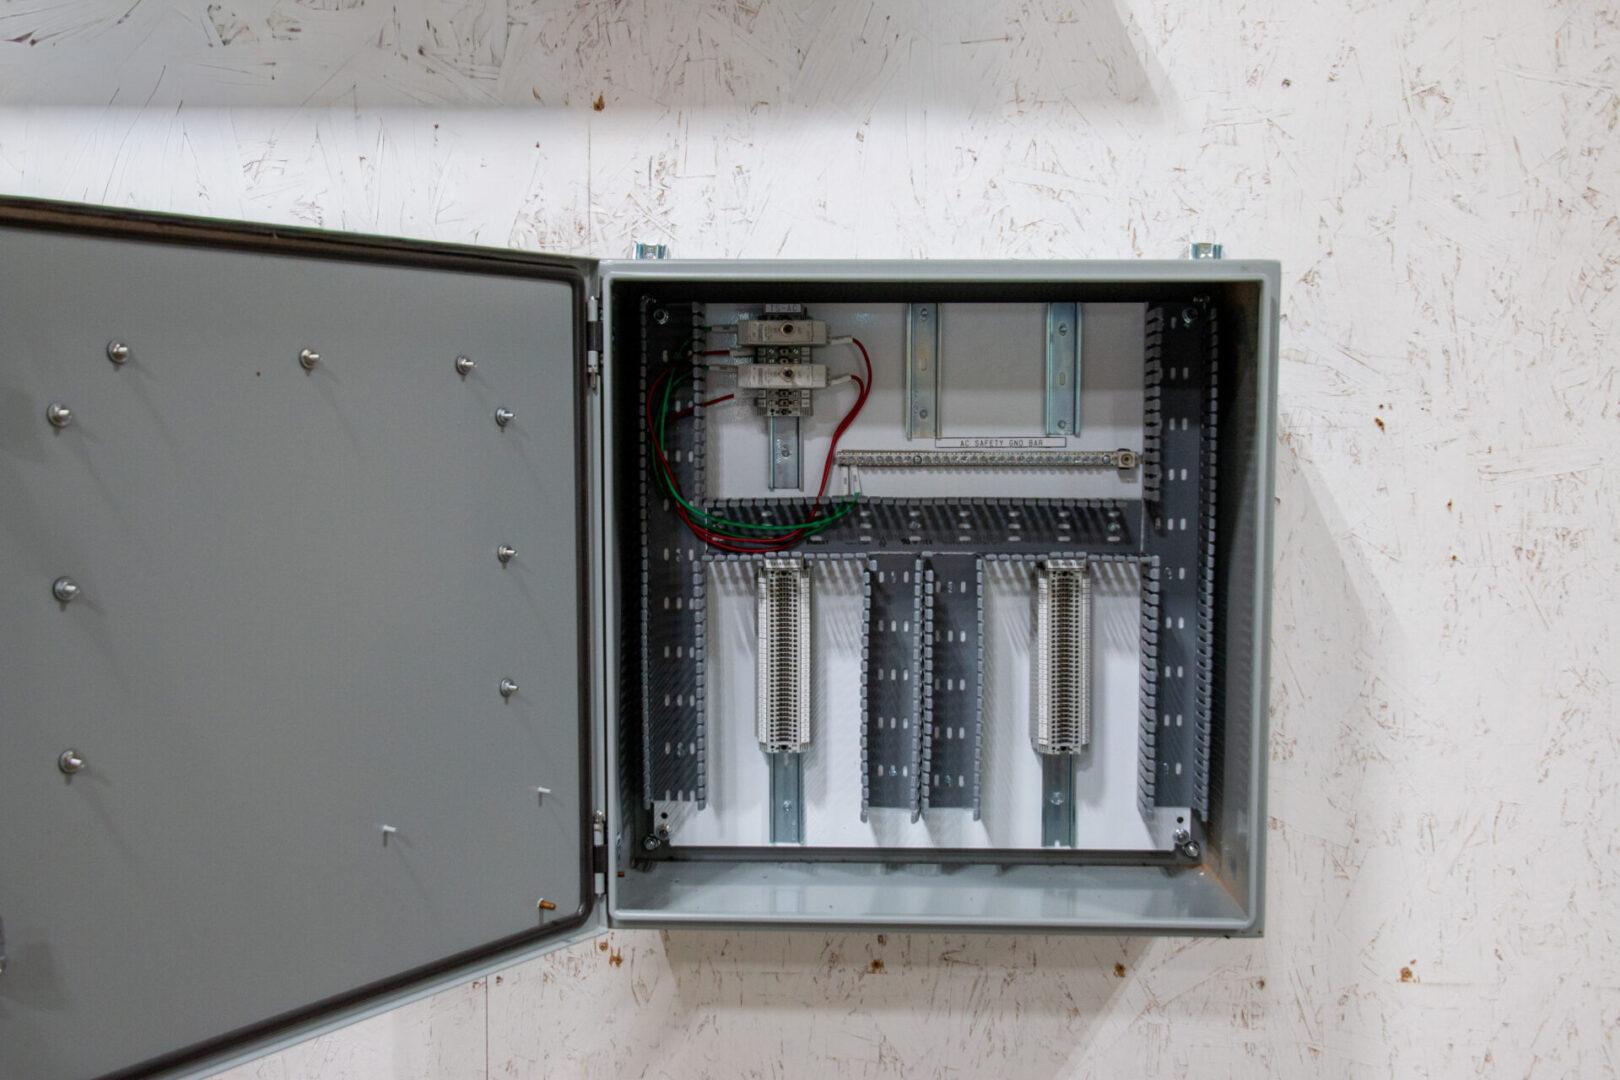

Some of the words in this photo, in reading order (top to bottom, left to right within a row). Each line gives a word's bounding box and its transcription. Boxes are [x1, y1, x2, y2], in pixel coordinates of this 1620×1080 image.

[960, 439, 970, 448] AC
[974, 439, 1004, 448] SAFETY
[1028, 439, 1043, 448] BAR
